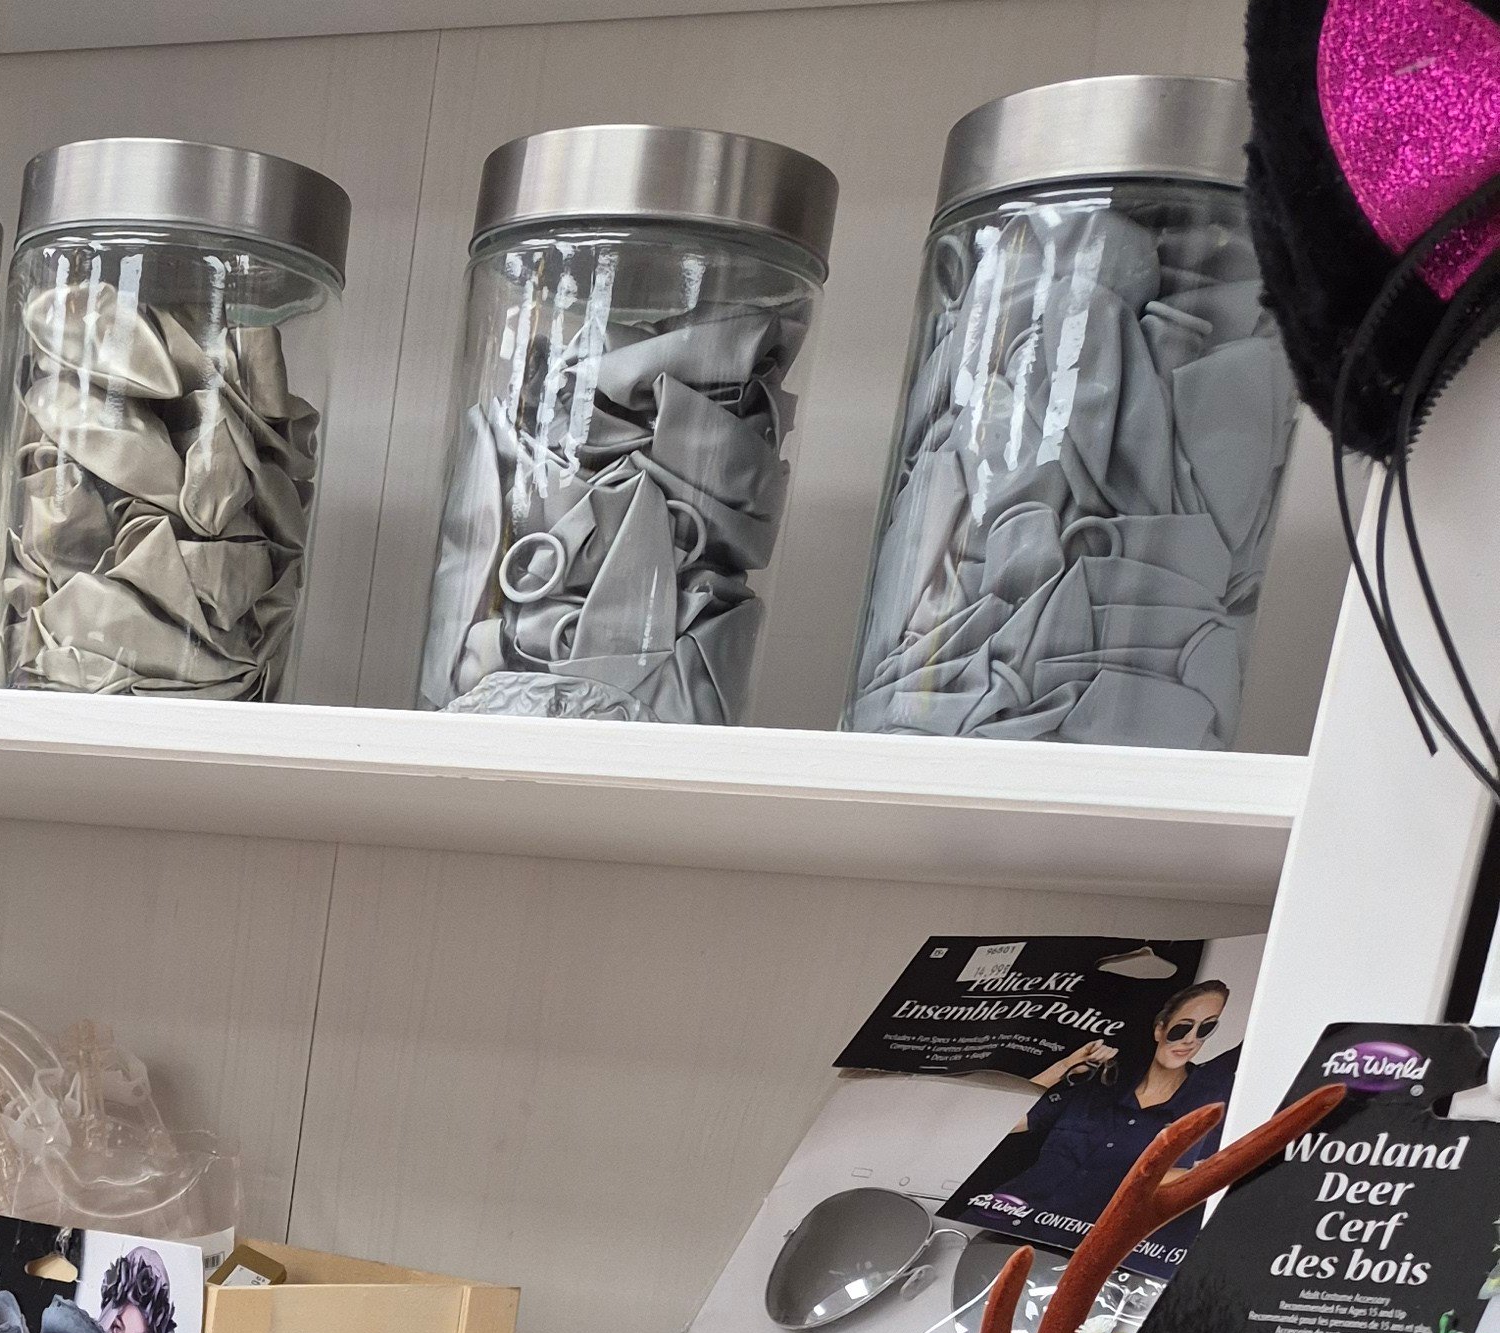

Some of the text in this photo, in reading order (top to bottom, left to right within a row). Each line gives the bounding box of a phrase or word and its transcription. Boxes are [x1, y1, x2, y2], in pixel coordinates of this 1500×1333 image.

[967, 972, 1086, 993] Police Kit
[891, 1000, 1126, 1036] Ensemble De Police
[1364, 1058, 1431, 1080] World
[1284, 1132, 1470, 1171] Wooland
[1315, 1172, 1415, 1206] Deer
[992, 1199, 1034, 1219] World
[1315, 1211, 1408, 1250] Cerf
[1165, 1247, 1188, 1265] (5)
[1270, 1245, 1432, 1286] des bois
